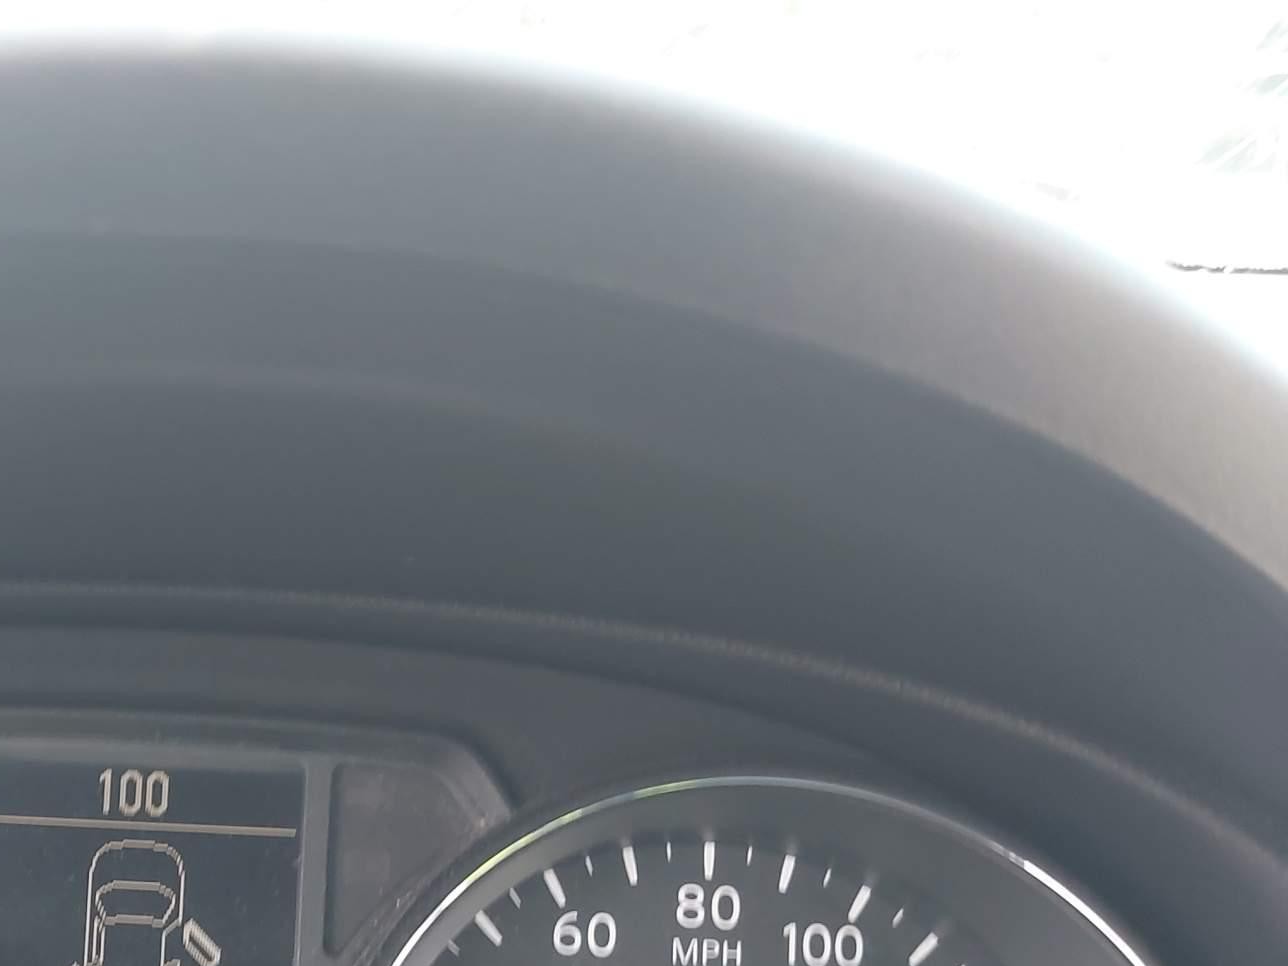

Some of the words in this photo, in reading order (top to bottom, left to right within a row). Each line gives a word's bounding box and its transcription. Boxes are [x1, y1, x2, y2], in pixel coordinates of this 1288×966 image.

[99, 767, 169, 817] 100
[675, 882, 742, 932] 80
[552, 910, 617, 958] 60
